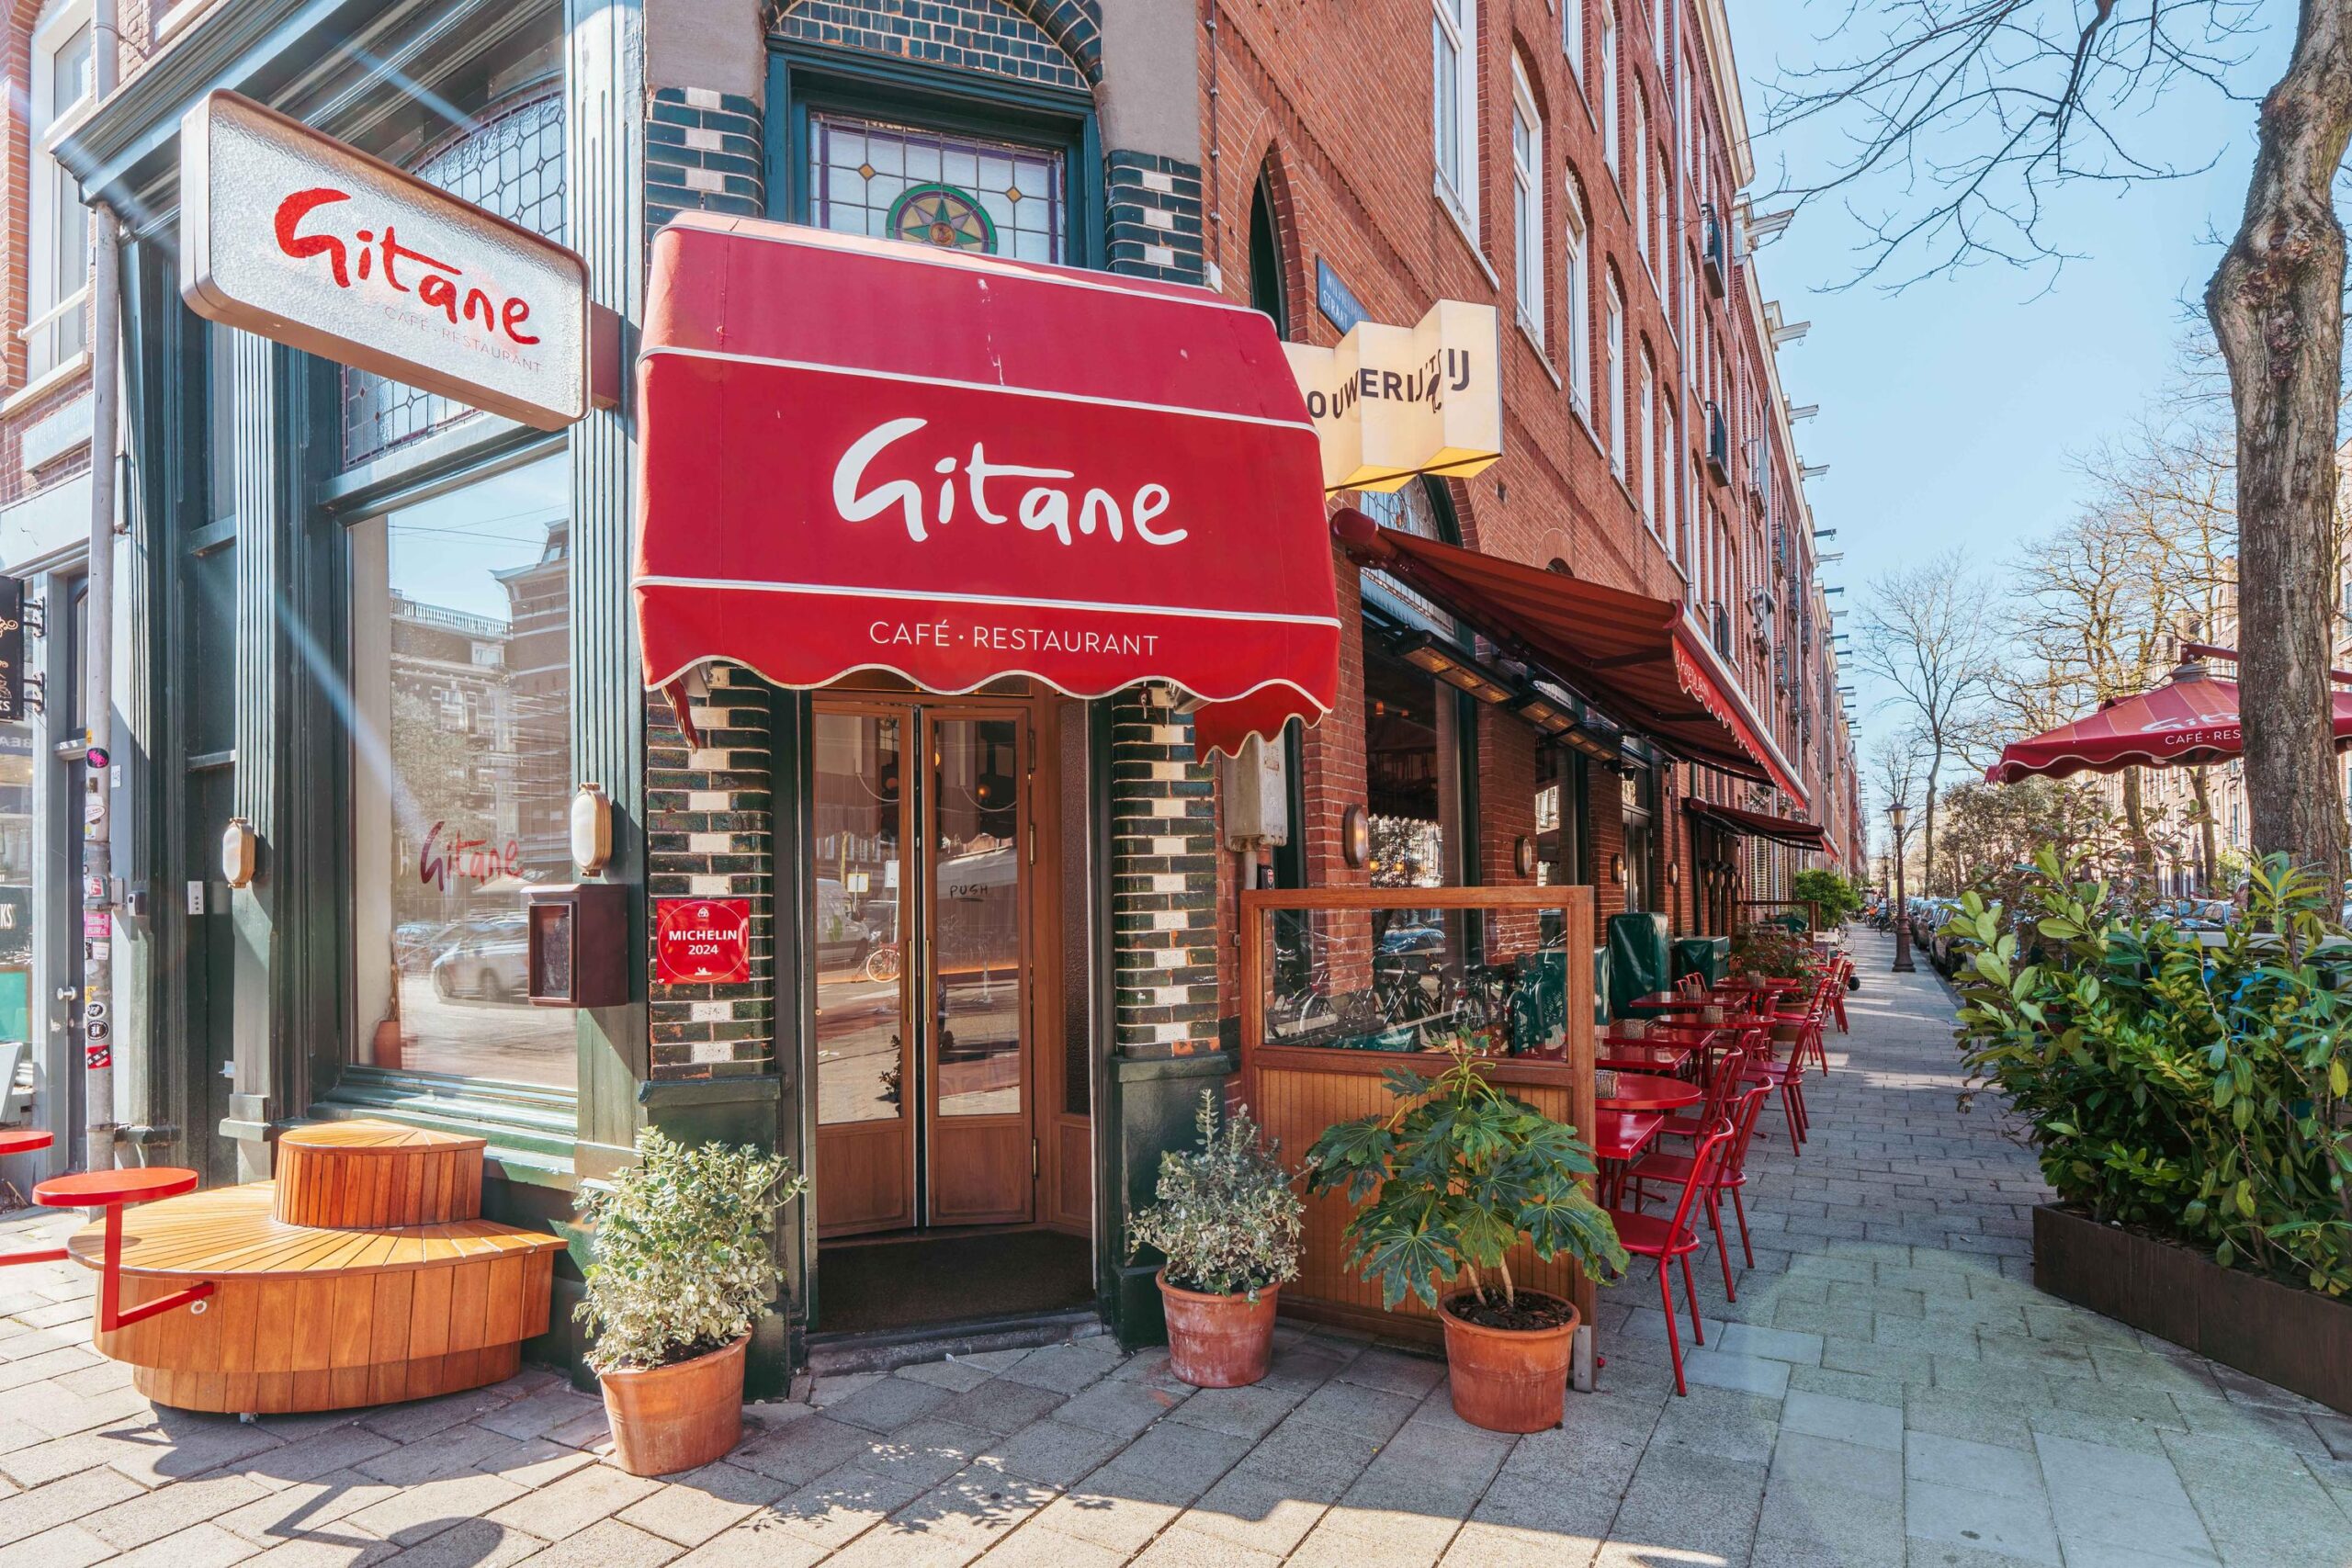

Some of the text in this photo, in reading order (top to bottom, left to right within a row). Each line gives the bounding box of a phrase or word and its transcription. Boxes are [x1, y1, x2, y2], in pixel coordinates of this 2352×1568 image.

[275, 187, 540, 345] Gitane
[1323, 289, 1348, 330] STRAAT
[441, 327, 543, 374] RESTAURANT
[1447, 348, 1470, 391] IJ
[832, 417, 1188, 546] Gitane
[869, 619, 1159, 656] CAFÉ RESTAURANT
[2165, 731, 2204, 745] CAFÉ
[420, 820, 525, 892] Gitane
[949, 884, 989, 900] PUSH
[668, 930, 738, 942] MICHELIN
[687, 944, 719, 955] 2024
